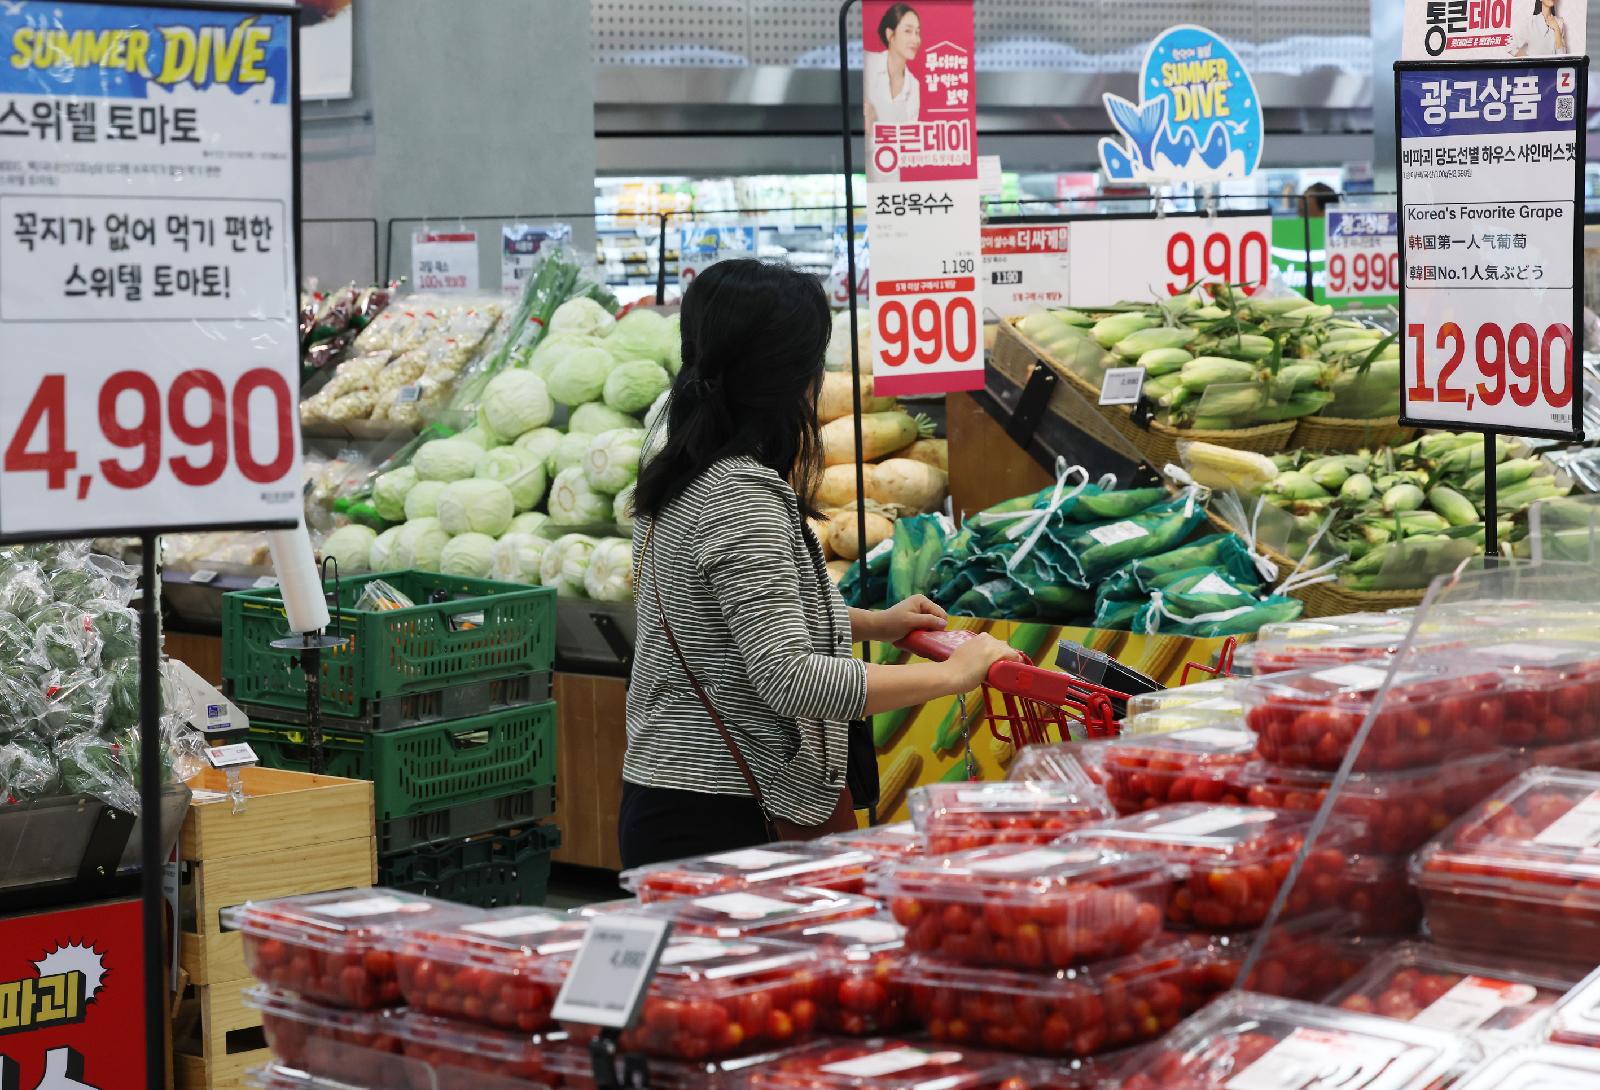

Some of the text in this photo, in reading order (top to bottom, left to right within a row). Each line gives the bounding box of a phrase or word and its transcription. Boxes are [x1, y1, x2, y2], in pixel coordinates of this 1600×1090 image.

[10, 24, 272, 85] SUMMER DIVE
[1161, 59, 1228, 86] SUMMER
[1172, 82, 1233, 121] DIVE
[1420, 75, 1542, 125] 광고상품
[0, 101, 201, 144] 스위텔 토마토
[873, 119, 970, 174] 통큰데이
[1402, 148, 1433, 168] 비파괴
[1436, 146, 1480, 165] 당도선별
[1482, 145, 1516, 165] 하우스
[875, 193, 954, 216] 초당옥수수
[1408, 204, 1564, 221] Korea's Favorite Grape
[14, 212, 274, 253] 꼭지가 없어 먹기 편한
[1408, 233, 1527, 250] 韩国第一人气葡萄
[64, 263, 230, 301] 스위텔 토마토!
[1166, 231, 1268, 297] 990
[1409, 264, 1544, 282] 韓国No.1人気ぶどう
[878, 297, 976, 367] 990
[1408, 322, 1573, 411] 12,990
[4, 367, 294, 500] 4,990
